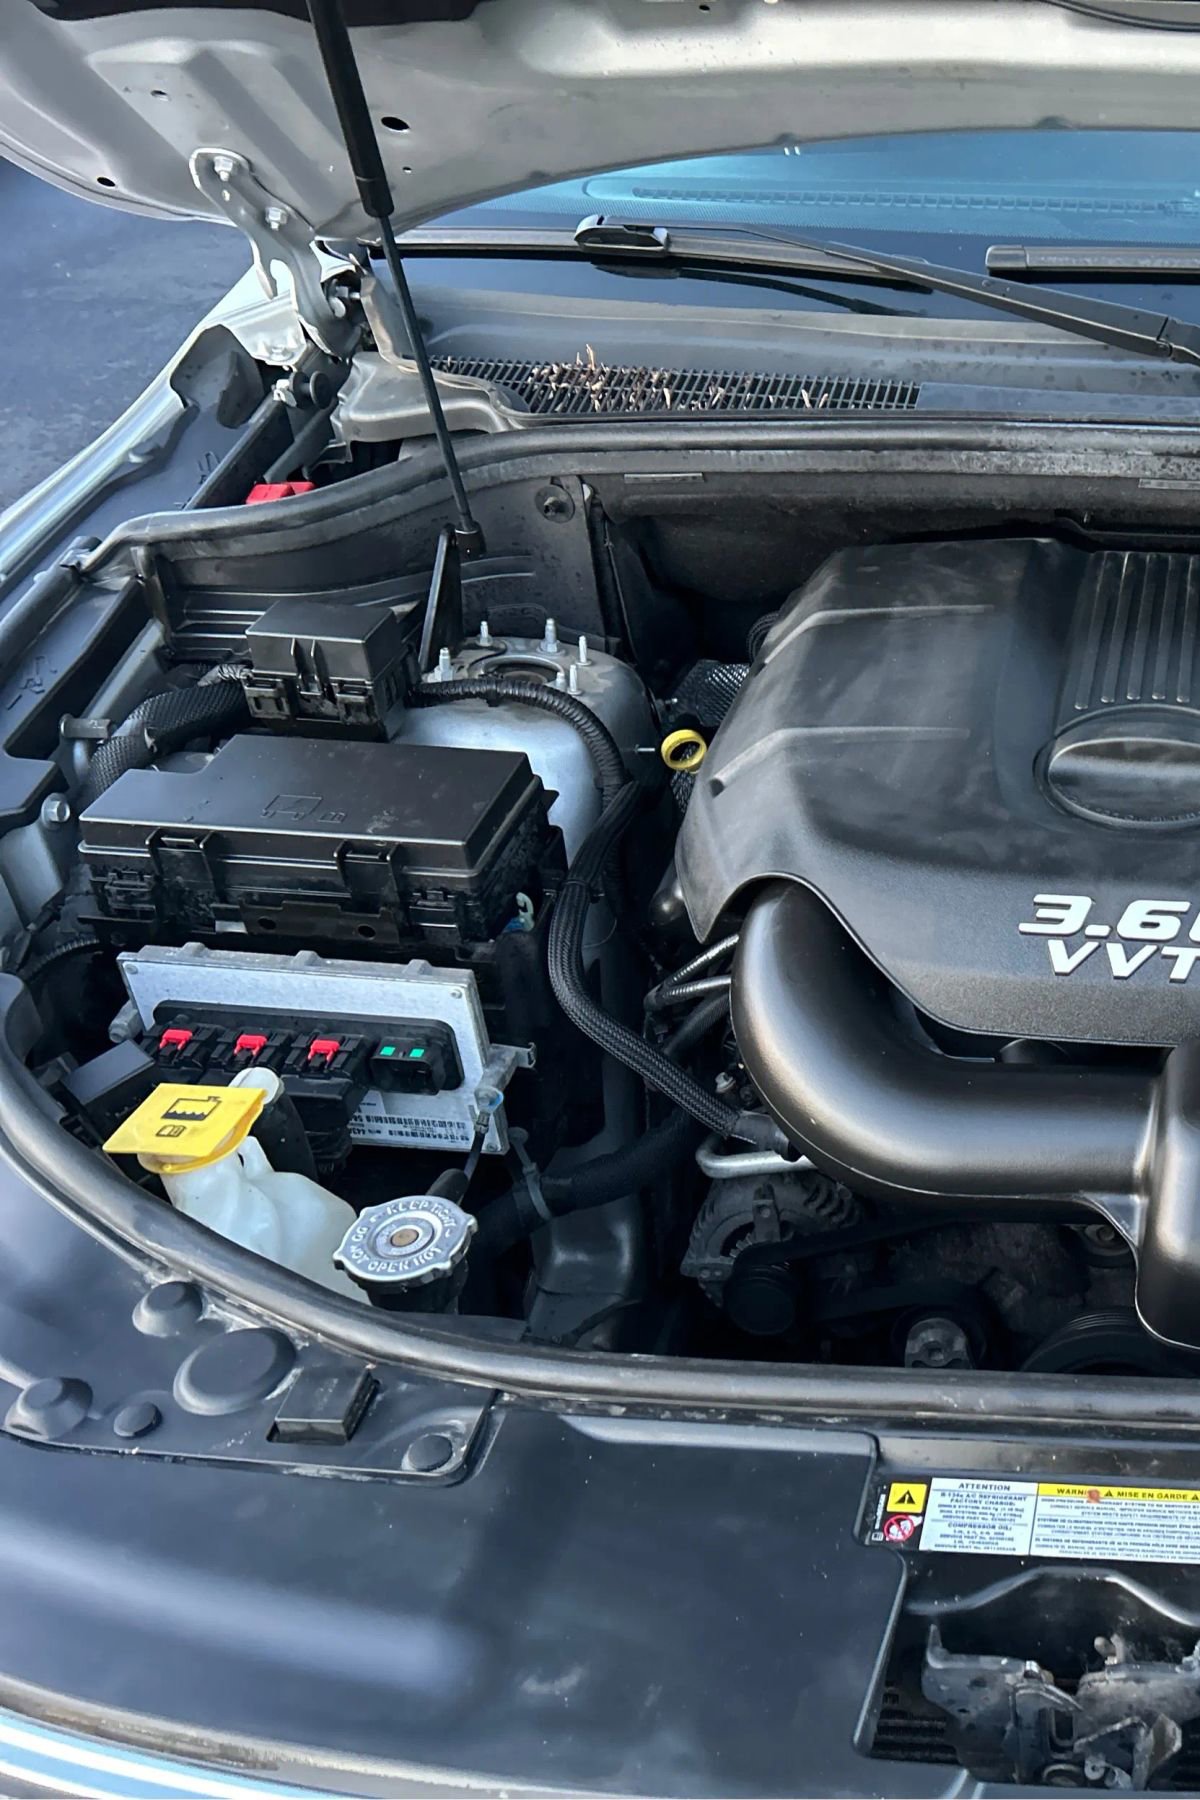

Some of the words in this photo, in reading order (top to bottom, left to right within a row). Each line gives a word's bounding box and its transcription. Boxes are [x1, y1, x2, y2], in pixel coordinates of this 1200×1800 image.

[958, 1482, 1011, 1492] ATTENTION
[1116, 1491, 1139, 1499] MISE
[1156, 1492, 1188, 1500] GARDE
